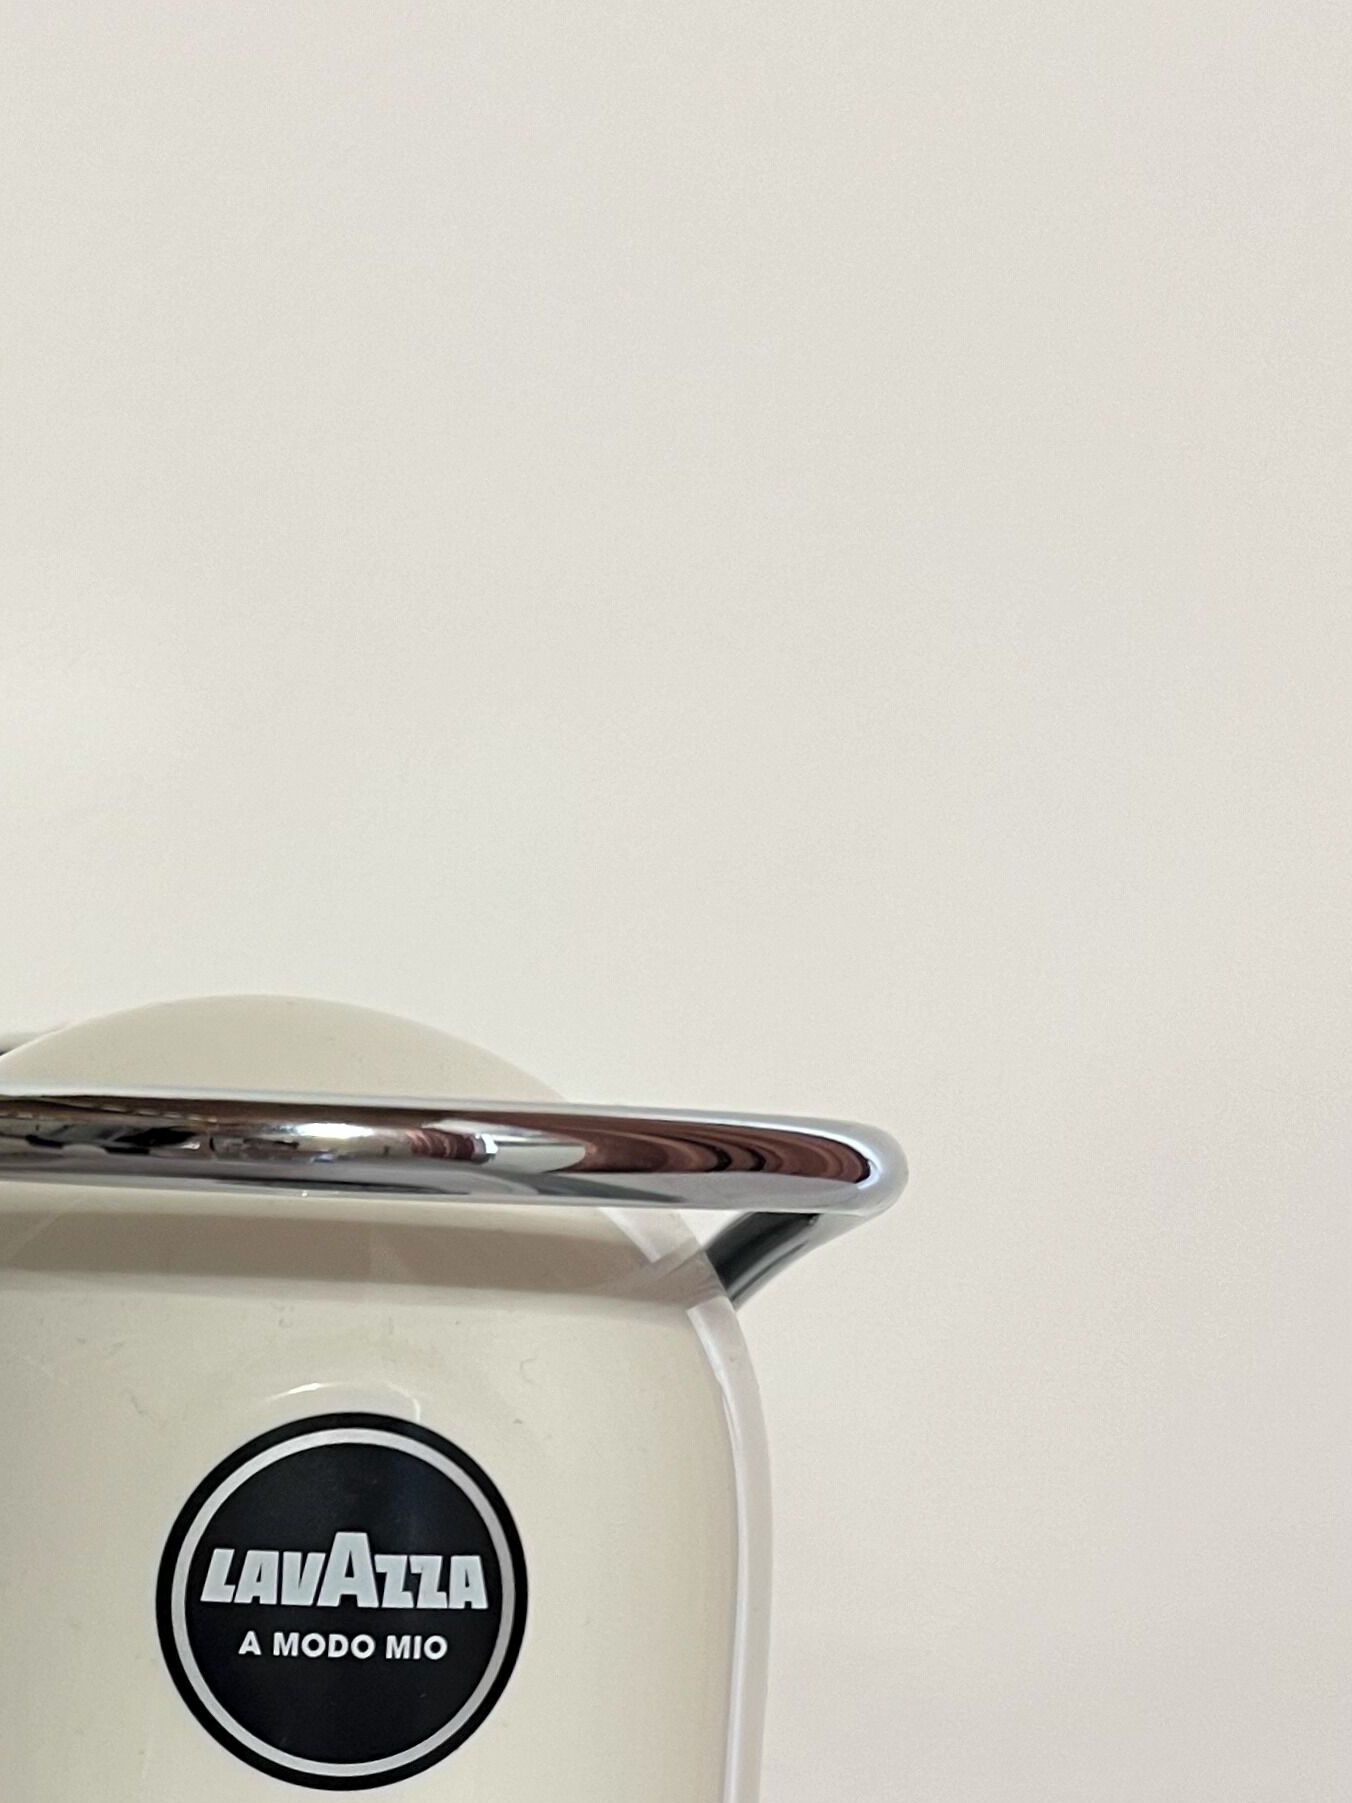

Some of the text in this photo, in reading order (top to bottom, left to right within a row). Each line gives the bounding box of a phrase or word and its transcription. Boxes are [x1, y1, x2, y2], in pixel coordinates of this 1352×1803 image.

[200, 1531, 489, 1609] LAVAZZA
[238, 1631, 448, 1660] A MODO MIO
